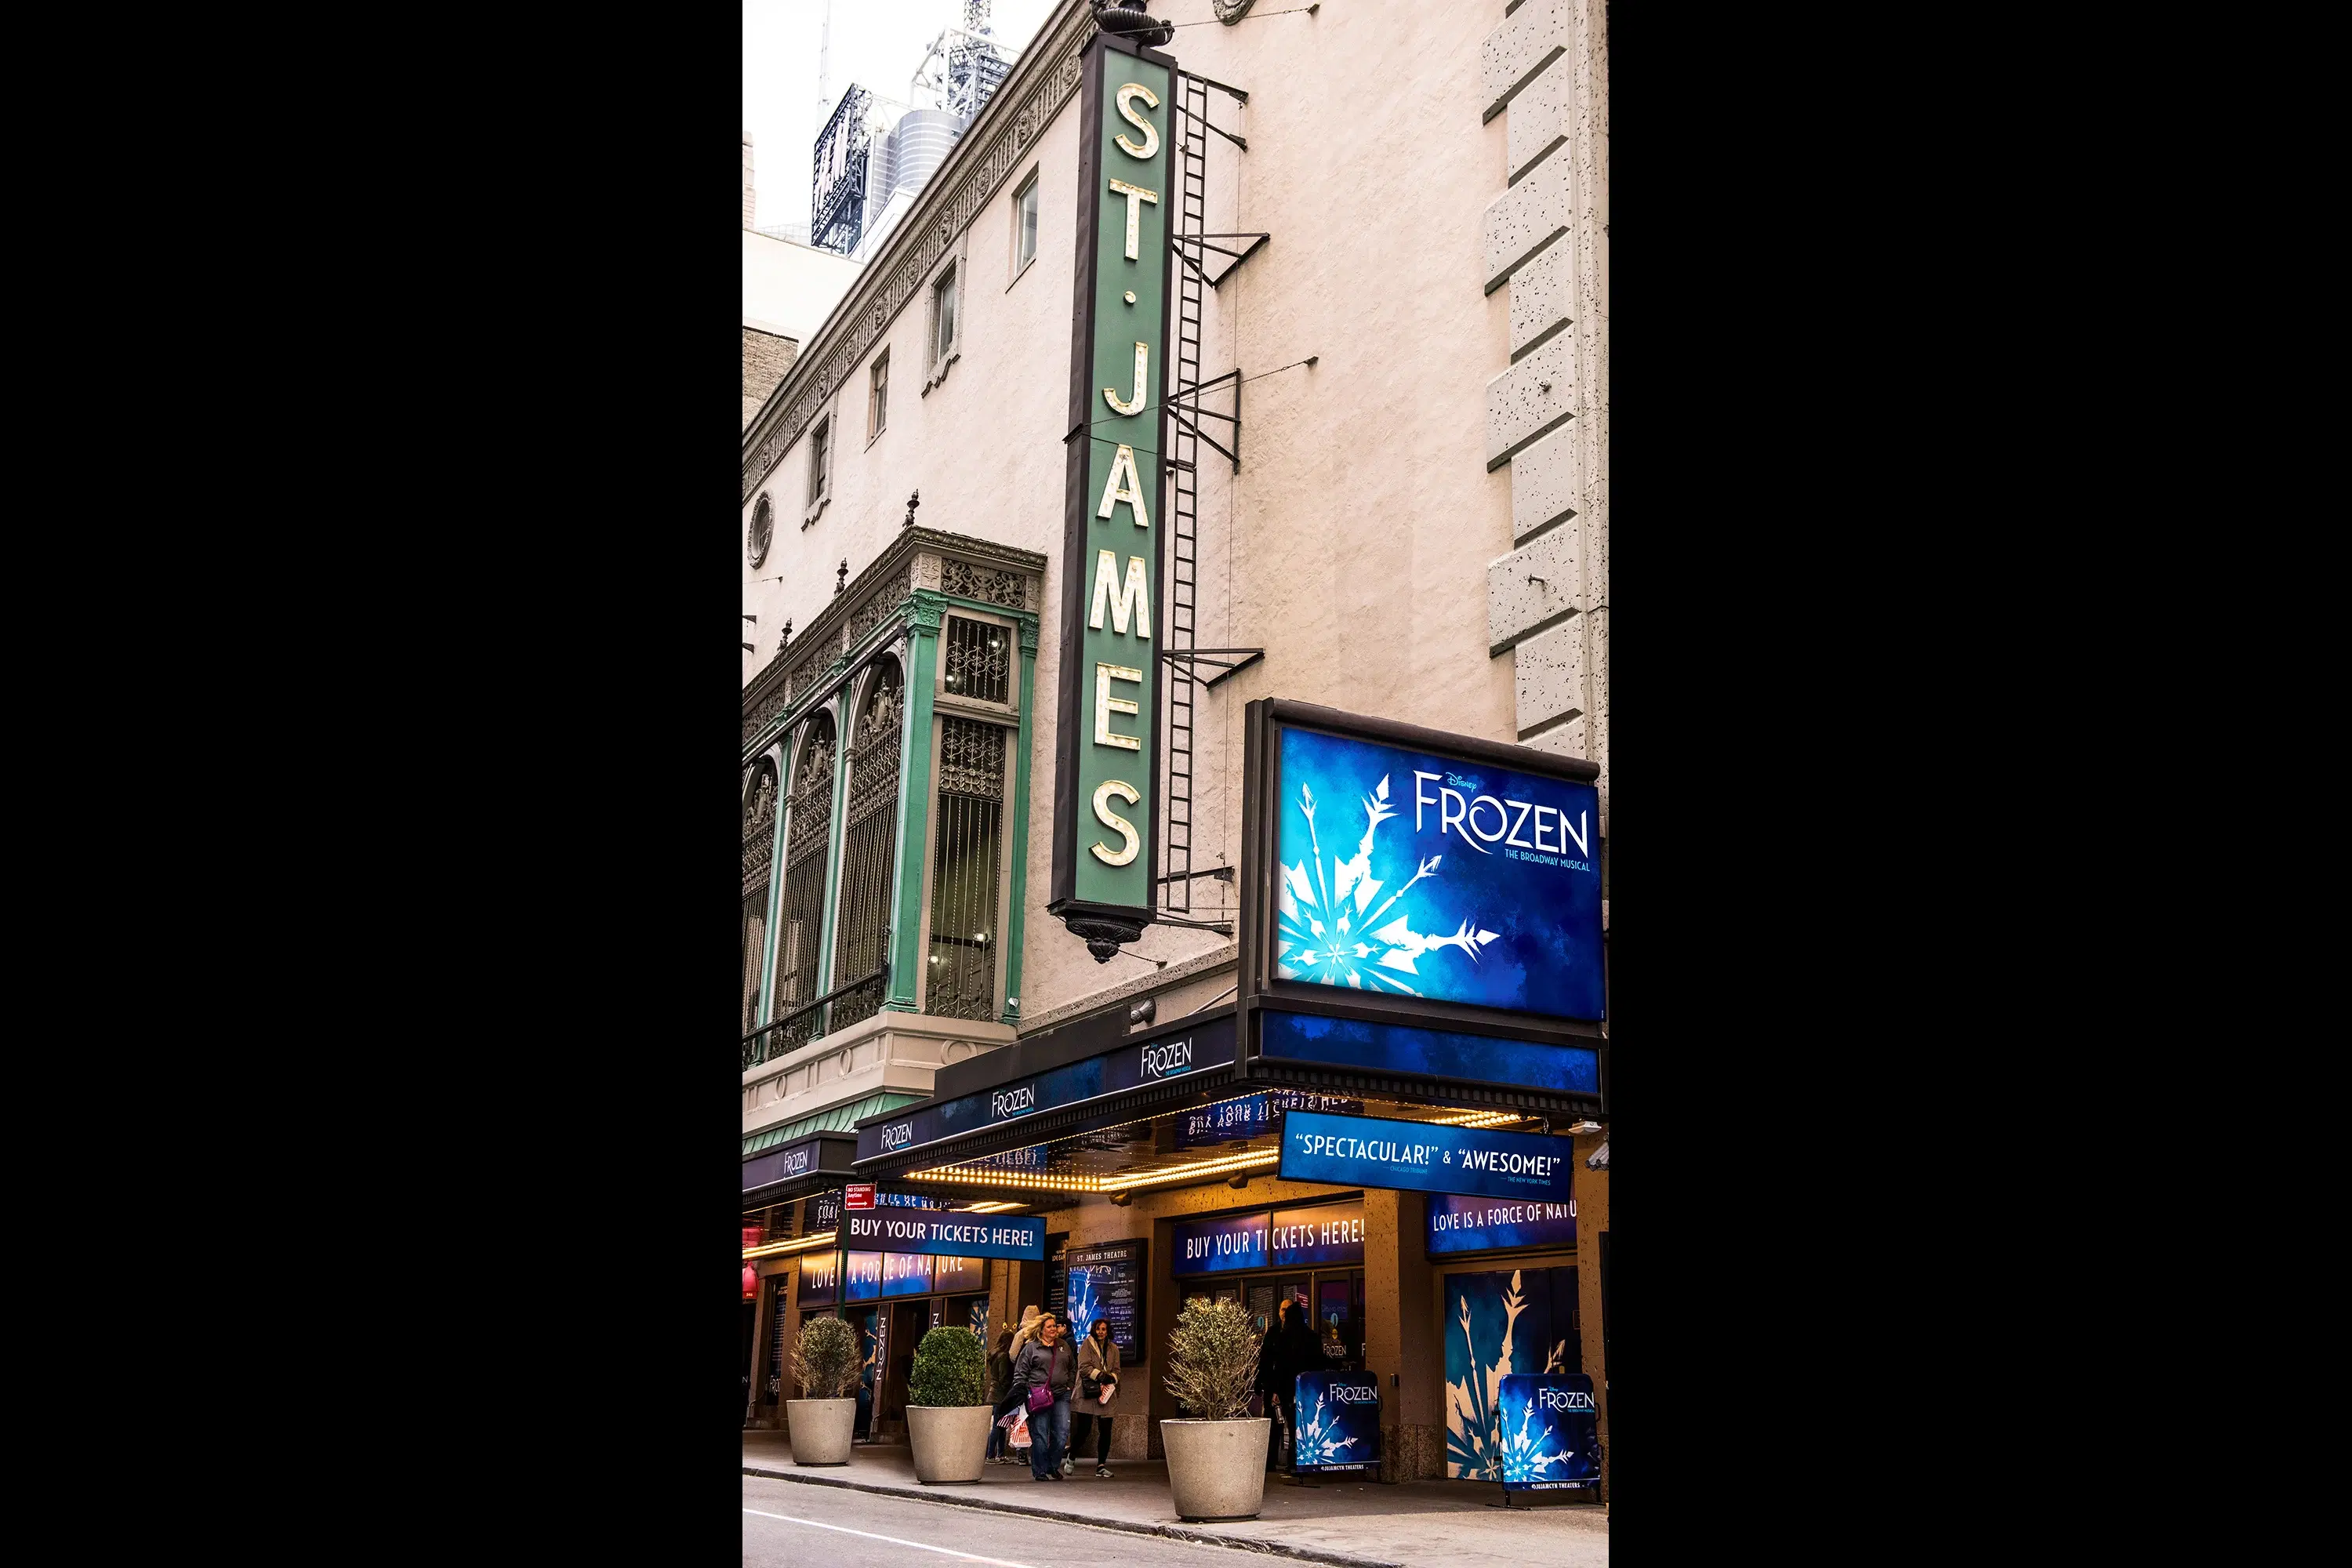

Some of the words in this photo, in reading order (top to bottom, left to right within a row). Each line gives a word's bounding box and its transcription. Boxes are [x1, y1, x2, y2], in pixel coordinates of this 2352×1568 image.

[1088, 341, 1151, 867] JAMES
[1445, 771, 1477, 793] Disney
[1413, 770, 1588, 858] FROZEN
[1504, 848, 1519, 860] THE
[1520, 851, 1559, 866] BROADWAY
[1560, 858, 1591, 872] MUSICAL
[1140, 1036, 1192, 1078] FROZEN
[992, 1083, 1035, 1118] FROZEN
[881, 1120, 913, 1151] FROZEN
[784, 1149, 808, 1175] FROZEN
[1443, 1150, 1451, 1164] &
[1433, 1212, 1459, 1232] LOVE
[1464, 1211, 1473, 1229] IS
[1476, 1210, 1483, 1227] A
[1488, 1205, 1523, 1226] FORCE
[1526, 1203, 1541, 1222] OF
[851, 1218, 881, 1236] BUY
[886, 1221, 926, 1240] YOUR
[931, 1223, 988, 1244] TICKETS
[993, 1228, 1033, 1247] HERE!
[1187, 1236, 1210, 1259] BUY
[1216, 1231, 1249, 1256] YOUR
[1256, 1224, 1315, 1251] TICKETS
[1321, 1218, 1365, 1246] HERE!
[1104, 1250, 1127, 1259] THEATRE
[812, 1266, 835, 1289] LOVE
[851, 1265, 857, 1284] A
[861, 1258, 894, 1283] FORCE
[899, 1255, 912, 1279] OF
[1323, 1343, 1347, 1359] FROZEN
[1330, 1384, 1377, 1404] FROZEN
[1539, 1388, 1595, 1413] FROZEN
